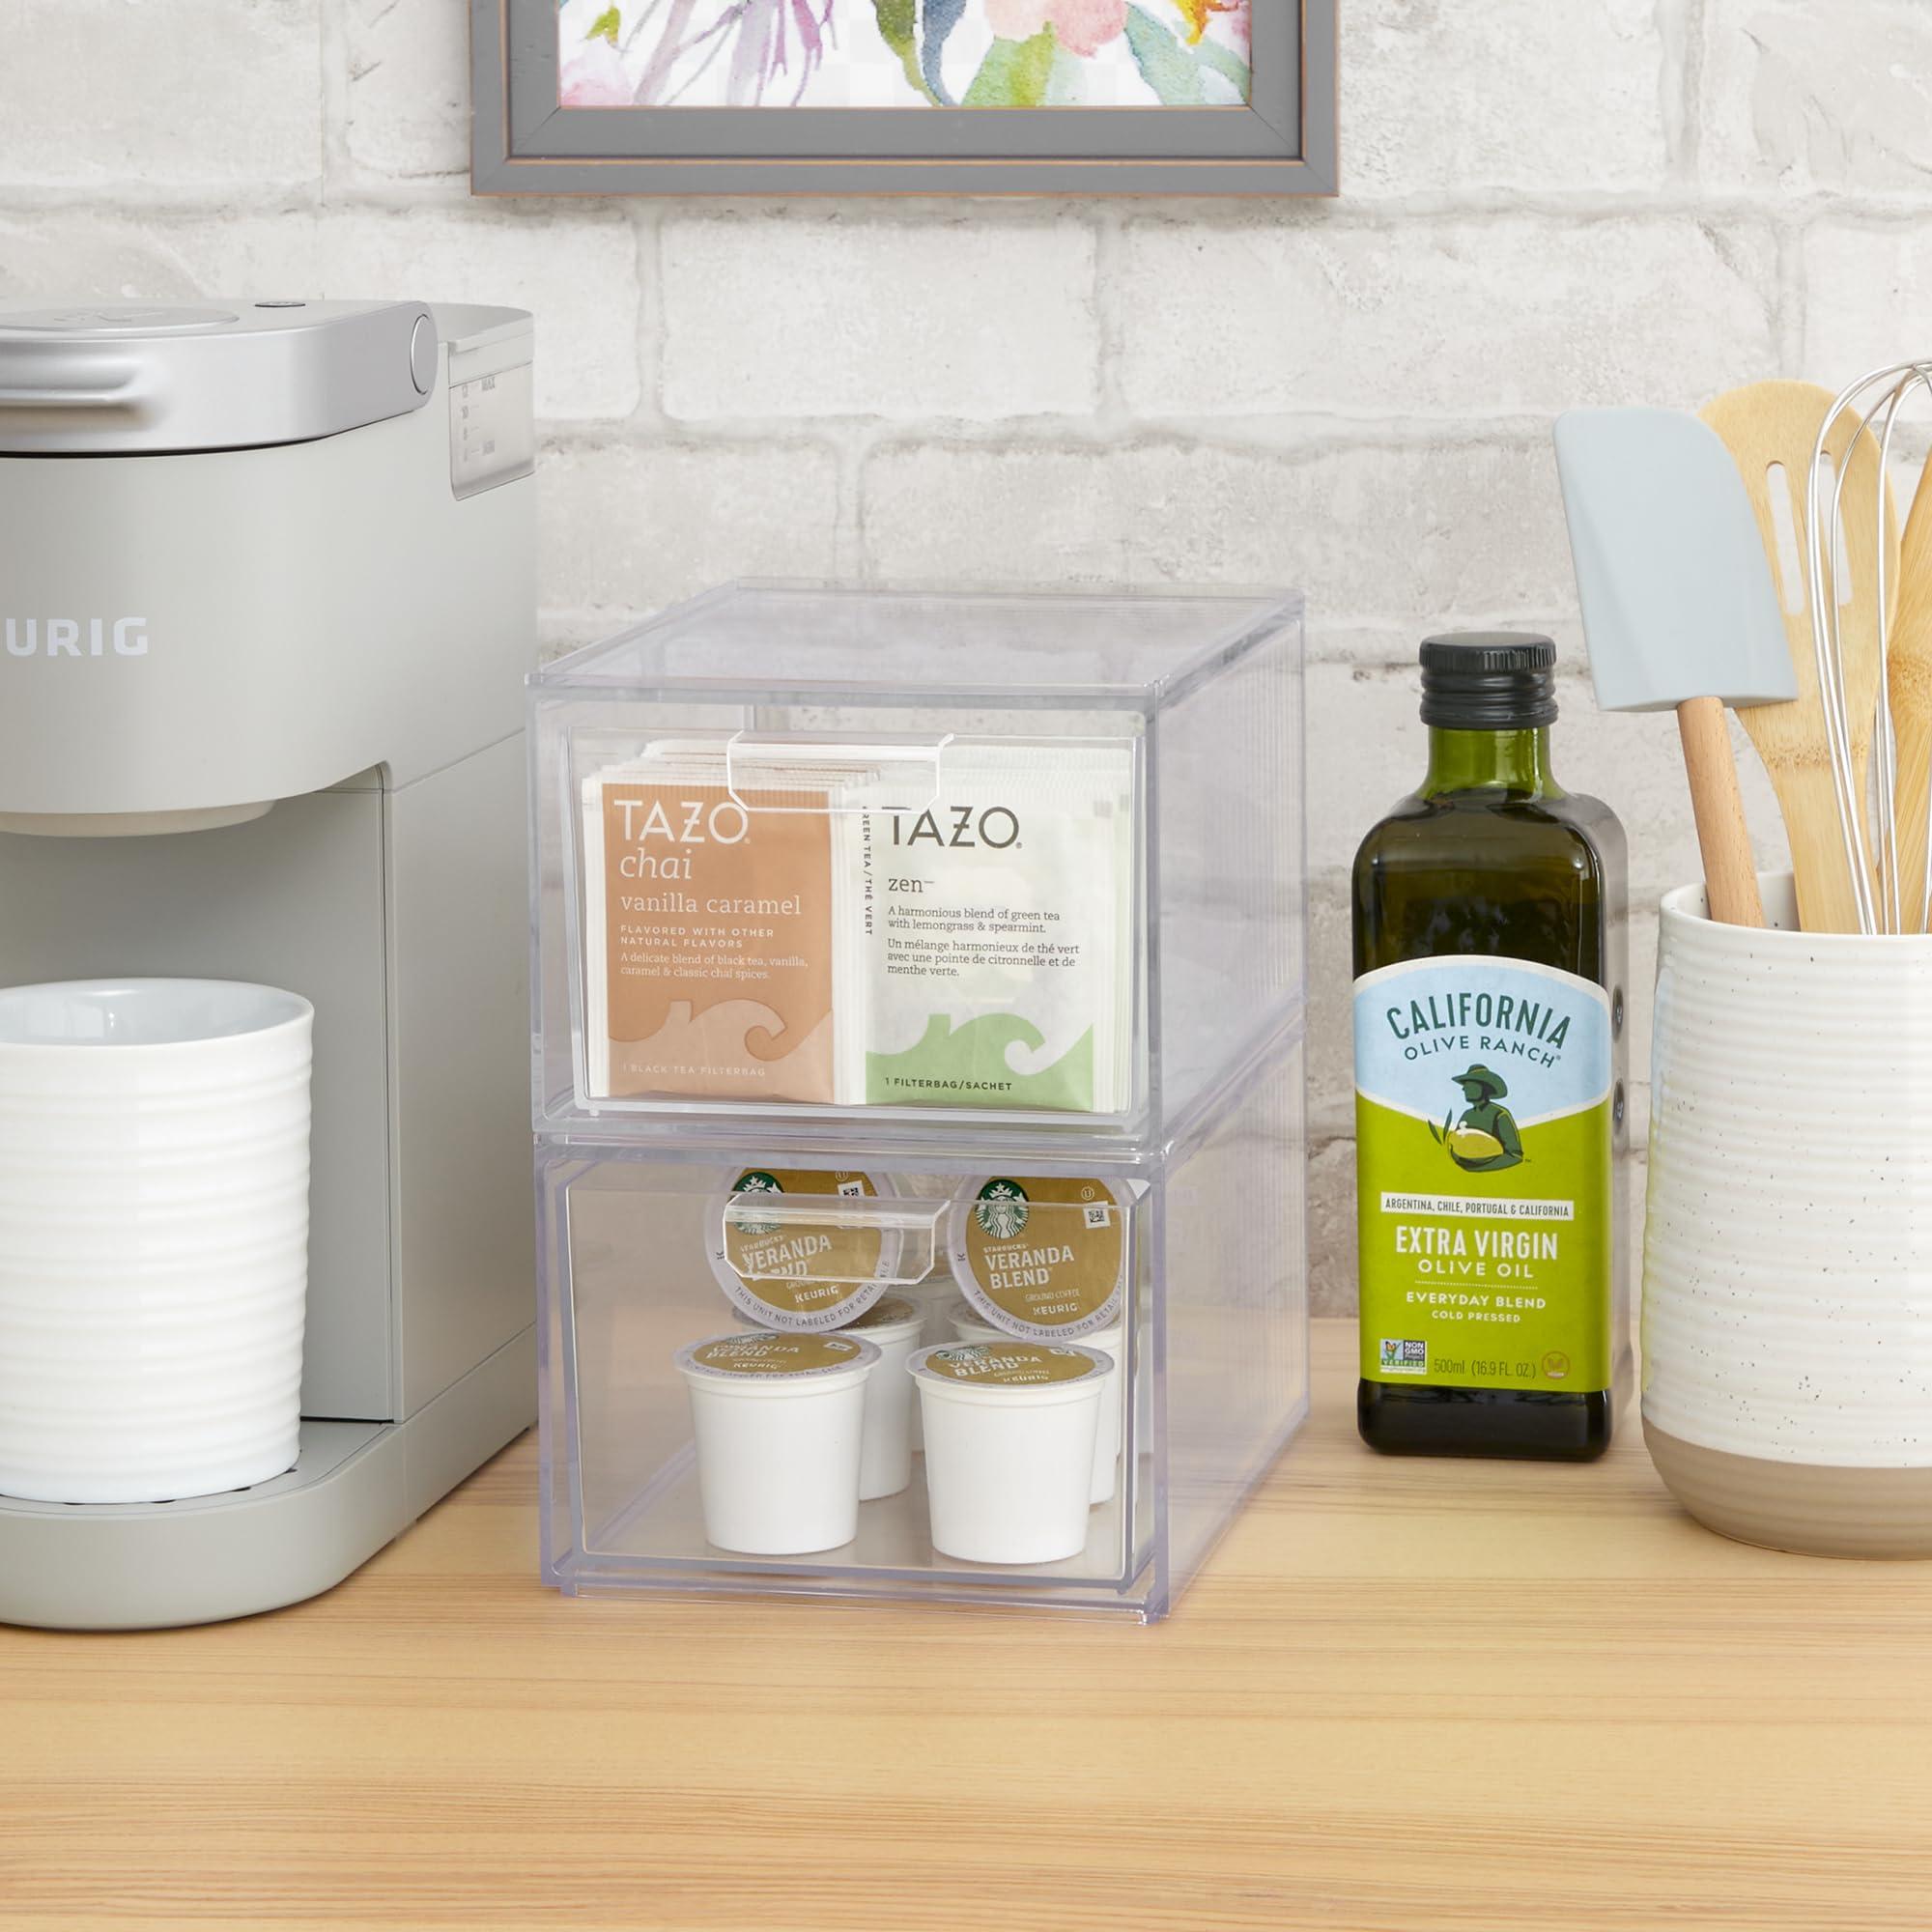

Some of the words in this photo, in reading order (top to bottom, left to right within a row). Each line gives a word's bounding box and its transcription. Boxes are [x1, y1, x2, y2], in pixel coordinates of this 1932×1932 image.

[6, 617, 148, 656] URIG
[614, 799, 749, 844] TAZO
[862, 806, 872, 842] REEN
[881, 806, 1020, 848] TAZO
[620, 846, 692, 880] chai
[888, 878, 923, 893] zen
[620, 892, 697, 913] vanilla
[706, 895, 802, 915] caramel
[865, 905, 873, 935] VERT
[888, 906, 895, 916] A
[898, 905, 961, 918] harmonious
[964, 908, 995, 919] blend
[997, 909, 1009, 919] of
[1010, 911, 1040, 922] green
[1043, 912, 1061, 921] tea
[621, 924, 686, 936] FLAVORED
[693, 926, 724, 936] WITH
[731, 927, 774, 938] OTHER
[888, 918, 911, 928] with
[912, 920, 974, 933] lemongrass
[977, 922, 986, 931] &
[988, 923, 1046, 934] spearmint.
[620, 936, 677, 947] NATURAL
[683, 939, 743, 949] FLAVORS
[888, 938, 902, 949] Un
[904, 939, 950, 952] mélange
[952, 941, 1018, 953] harmonieux
[1021, 943, 1036, 953] de
[1037, 943, 1055, 953] thé
[1057, 945, 1080, 954] vert
[621, 952, 628, 961] A
[631, 952, 671, 963] delicate
[672, 953, 701, 964] blend
[704, 954, 715, 965] of
[718, 954, 745, 966] black
[748, 956, 767, 967] tea,
[770, 955, 809, 968] vanilla,
[887, 953, 910, 962] avec
[912, 954, 932, 963] une
[934, 953, 970, 965] pointe
[972, 954, 986, 964] de
[987, 954, 1046, 966] citronnelle
[1048, 957, 1060, 967] et
[1062, 957, 1076, 967] de
[621, 966, 660, 977] caramel
[673, 967, 709, 978] classic
[711, 968, 732, 979] chai
[887, 965, 927, 976] menthe
[929, 967, 960, 977] verte.
[1386, 993, 1571, 1049] CALIFORNIA
[1405, 1036, 1469, 1061] OLIVE
[1480, 1036, 1556, 1068] RANCH
[631, 1064, 668, 1074] BLACK
[673, 1065, 696, 1075] TEA
[700, 1065, 766, 1077] FILTERBAG
[894, 1078, 1013, 1091] FILTERBAG/SACHET
[1385, 1198, 1435, 1211] ARGENTINA,
[1437, 1201, 1463, 1213] CHILE,
[1465, 1203, 1508, 1215] PORTUGAL
[1511, 1205, 1516, 1214] &
[1520, 1205, 1569, 1217] CALIFORNIA
[742, 1235, 833, 1270] VERANDA
[1396, 1226, 1466, 1256] EXTRA
[1474, 1230, 1557, 1260] VIRGIN
[985, 1245, 1074, 1271] VERANDA
[1418, 1259, 1486, 1276] OLIVE
[1497, 1263, 1534, 1278] OIL
[990, 1267, 1051, 1290] BLEND
[794, 1285, 839, 1303] KEURIG
[1406, 1291, 1490, 1307] EVERYDAY
[1496, 1295, 1547, 1310] BLEND
[734, 1286, 752, 1306] THIS
[753, 1304, 774, 1319] UNIT
[775, 1314, 792, 1326] NOT
[796, 1314, 838, 1327] LABELED
[838, 1303, 855, 1318] FOR
[1033, 1302, 1078, 1316] KEURIG
[1432, 1309, 1463, 1321] COLD
[1468, 1311, 1520, 1323] PRESSED
[991, 1309, 1010, 1323] UNIT
[1012, 1321, 1031, 1334] NOT
[1033, 1327, 1074, 1338] LABELED
[1077, 1320, 1094, 1332] FOR
[954, 1361, 1019, 1378] BLEND
